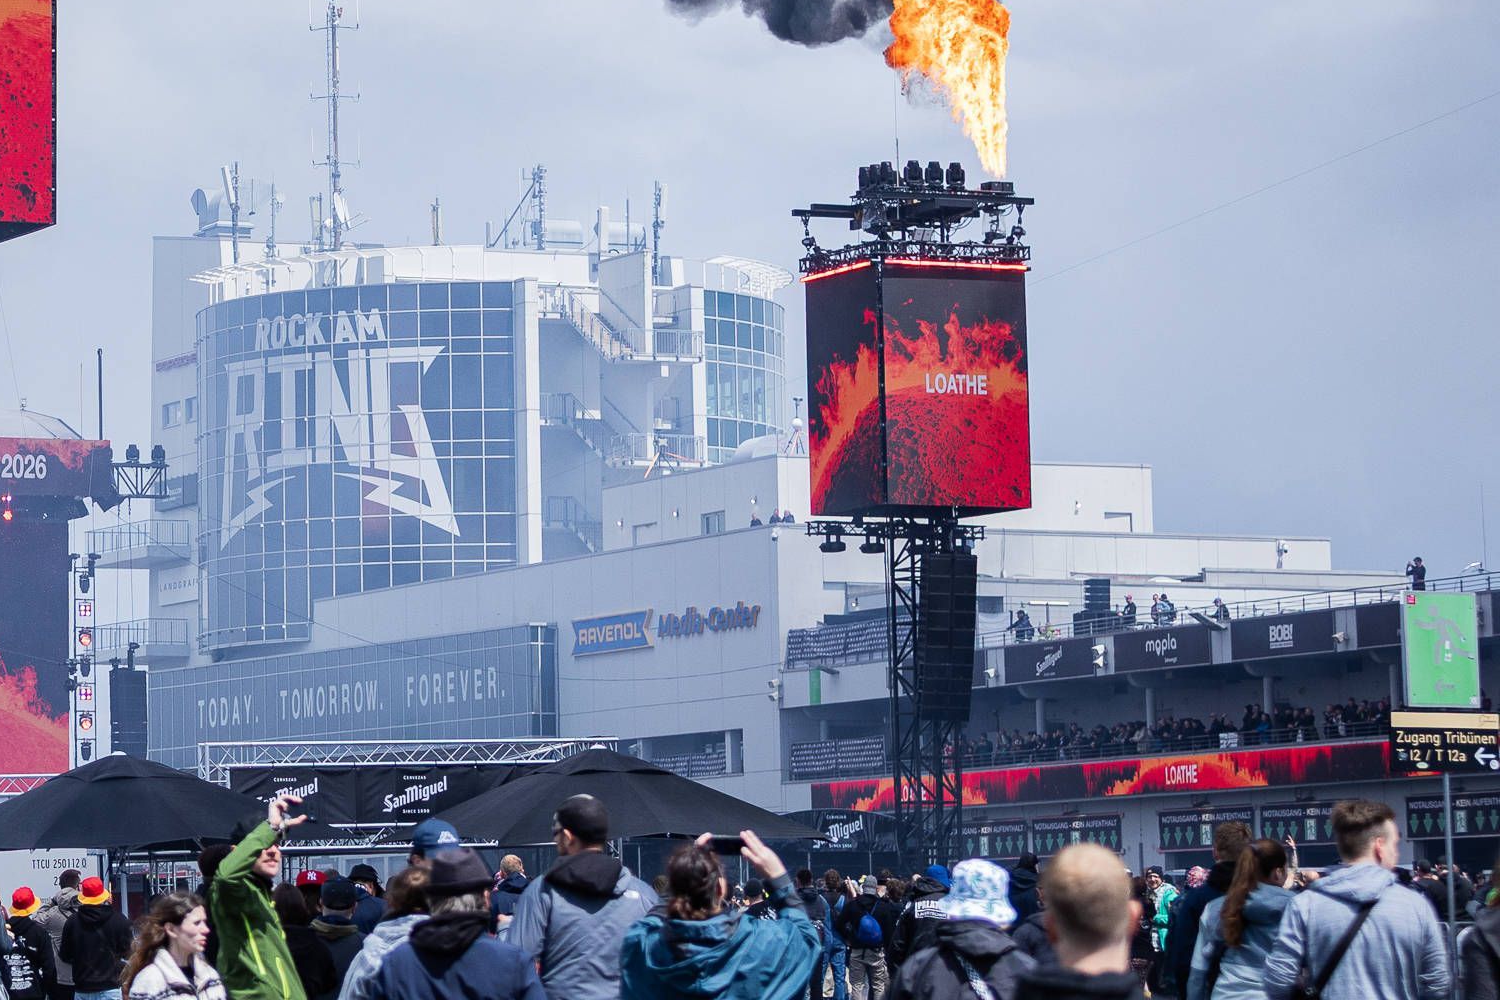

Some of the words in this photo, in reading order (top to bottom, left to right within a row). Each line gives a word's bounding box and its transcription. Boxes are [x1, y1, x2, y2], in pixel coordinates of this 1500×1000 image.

[255, 312, 326, 351] ROCK
[333, 307, 387, 343] AM
[925, 373, 988, 395] LOATHE
[220, 345, 461, 551] RING
[1, 454, 47, 479] 2026
[578, 621, 642, 646] RAVENOL
[1269, 623, 1293, 642] BOB!
[1145, 633, 1177, 657] mopla
[198, 694, 259, 729] TODAY.
[279, 680, 384, 720] TOMORROW.
[406, 667, 505, 708] FOREVER.
[1396, 730, 1442, 746] Zugang
[1444, 731, 1496, 744] Tribünen
[1410, 749, 1421, 761] 12
[1435, 749, 1443, 761] T
[1447, 749, 1467, 761] 12a
[1164, 764, 1198, 785] LOATHE
[1202, 813, 1215, 822] KEIN
[1306, 808, 1320, 816] KEIN
[1072, 819, 1084, 829] KEIN
[32, 859, 50, 869] TTCU
[53, 859, 80, 869] 250112
